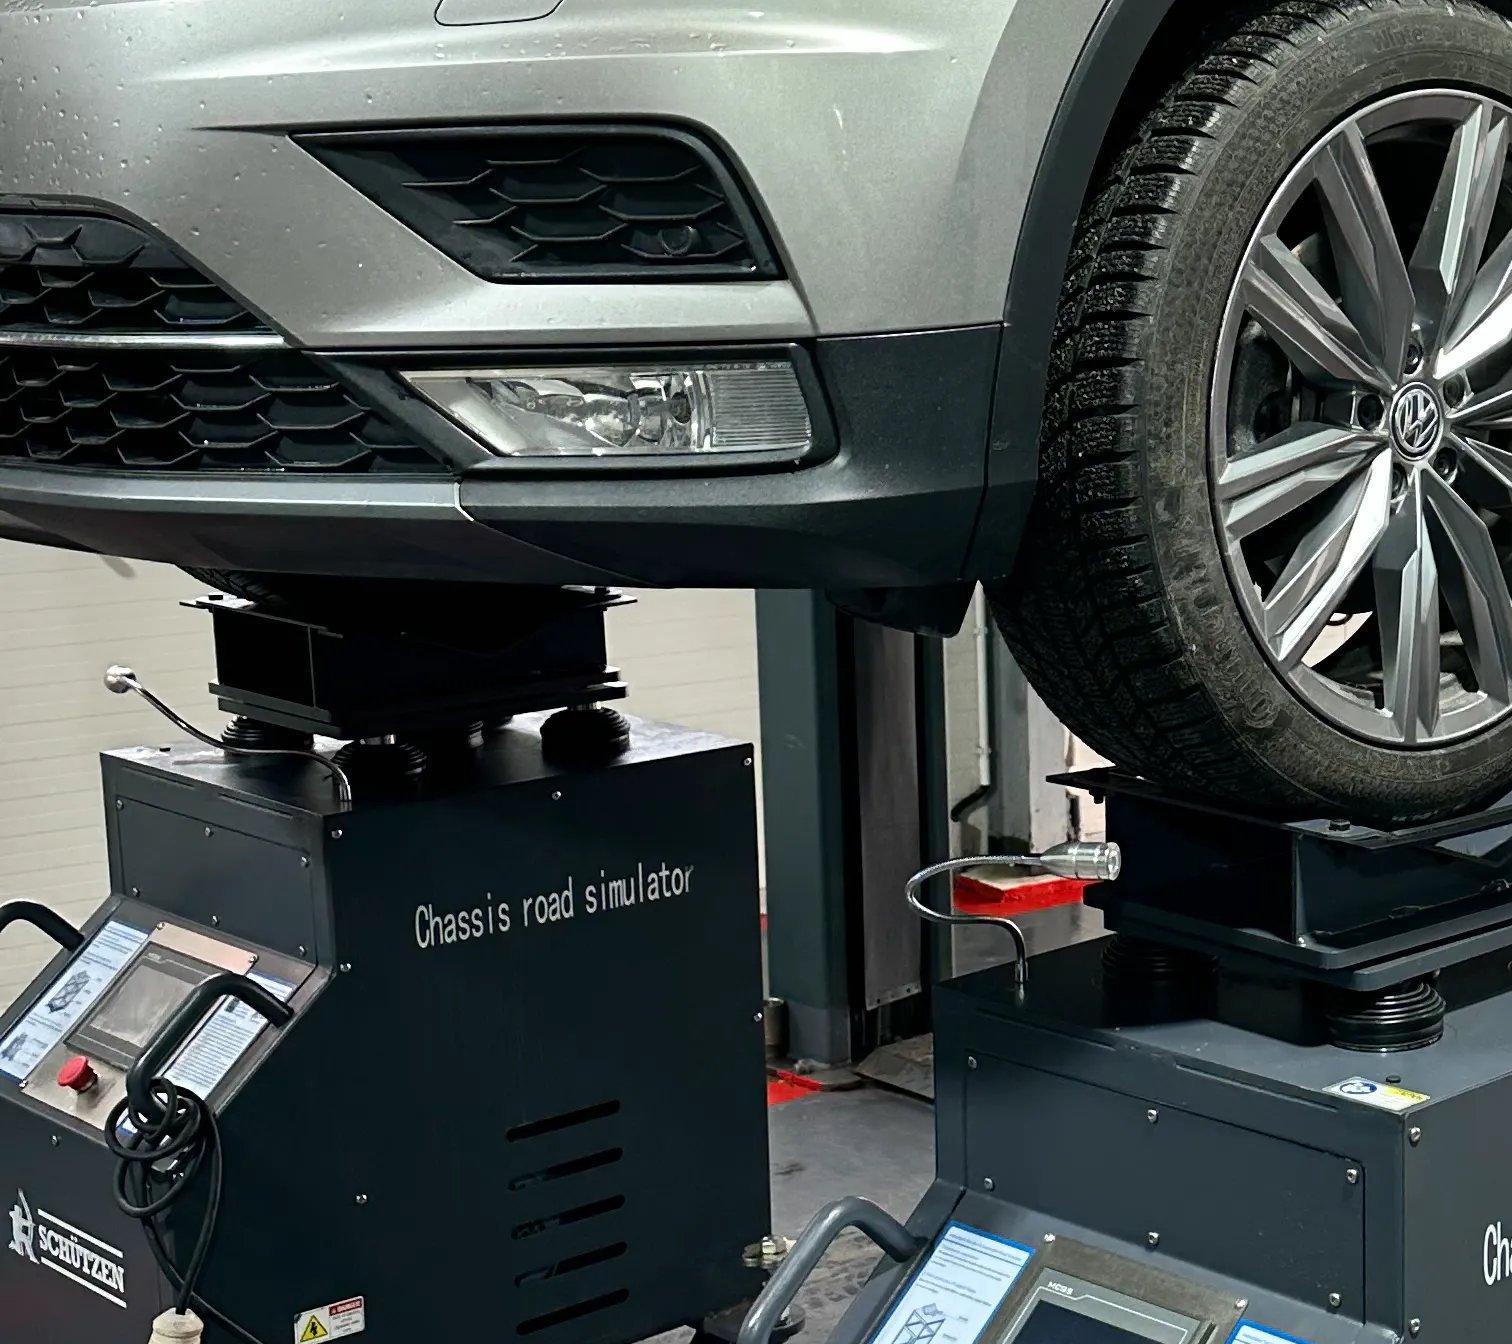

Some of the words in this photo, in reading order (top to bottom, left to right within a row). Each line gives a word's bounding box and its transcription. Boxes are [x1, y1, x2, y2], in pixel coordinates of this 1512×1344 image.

[414, 892, 511, 949] Chassis
[522, 875, 575, 928] road
[585, 861, 695, 914] simulator
[37, 1223, 125, 1293] SCHÜTZEN
